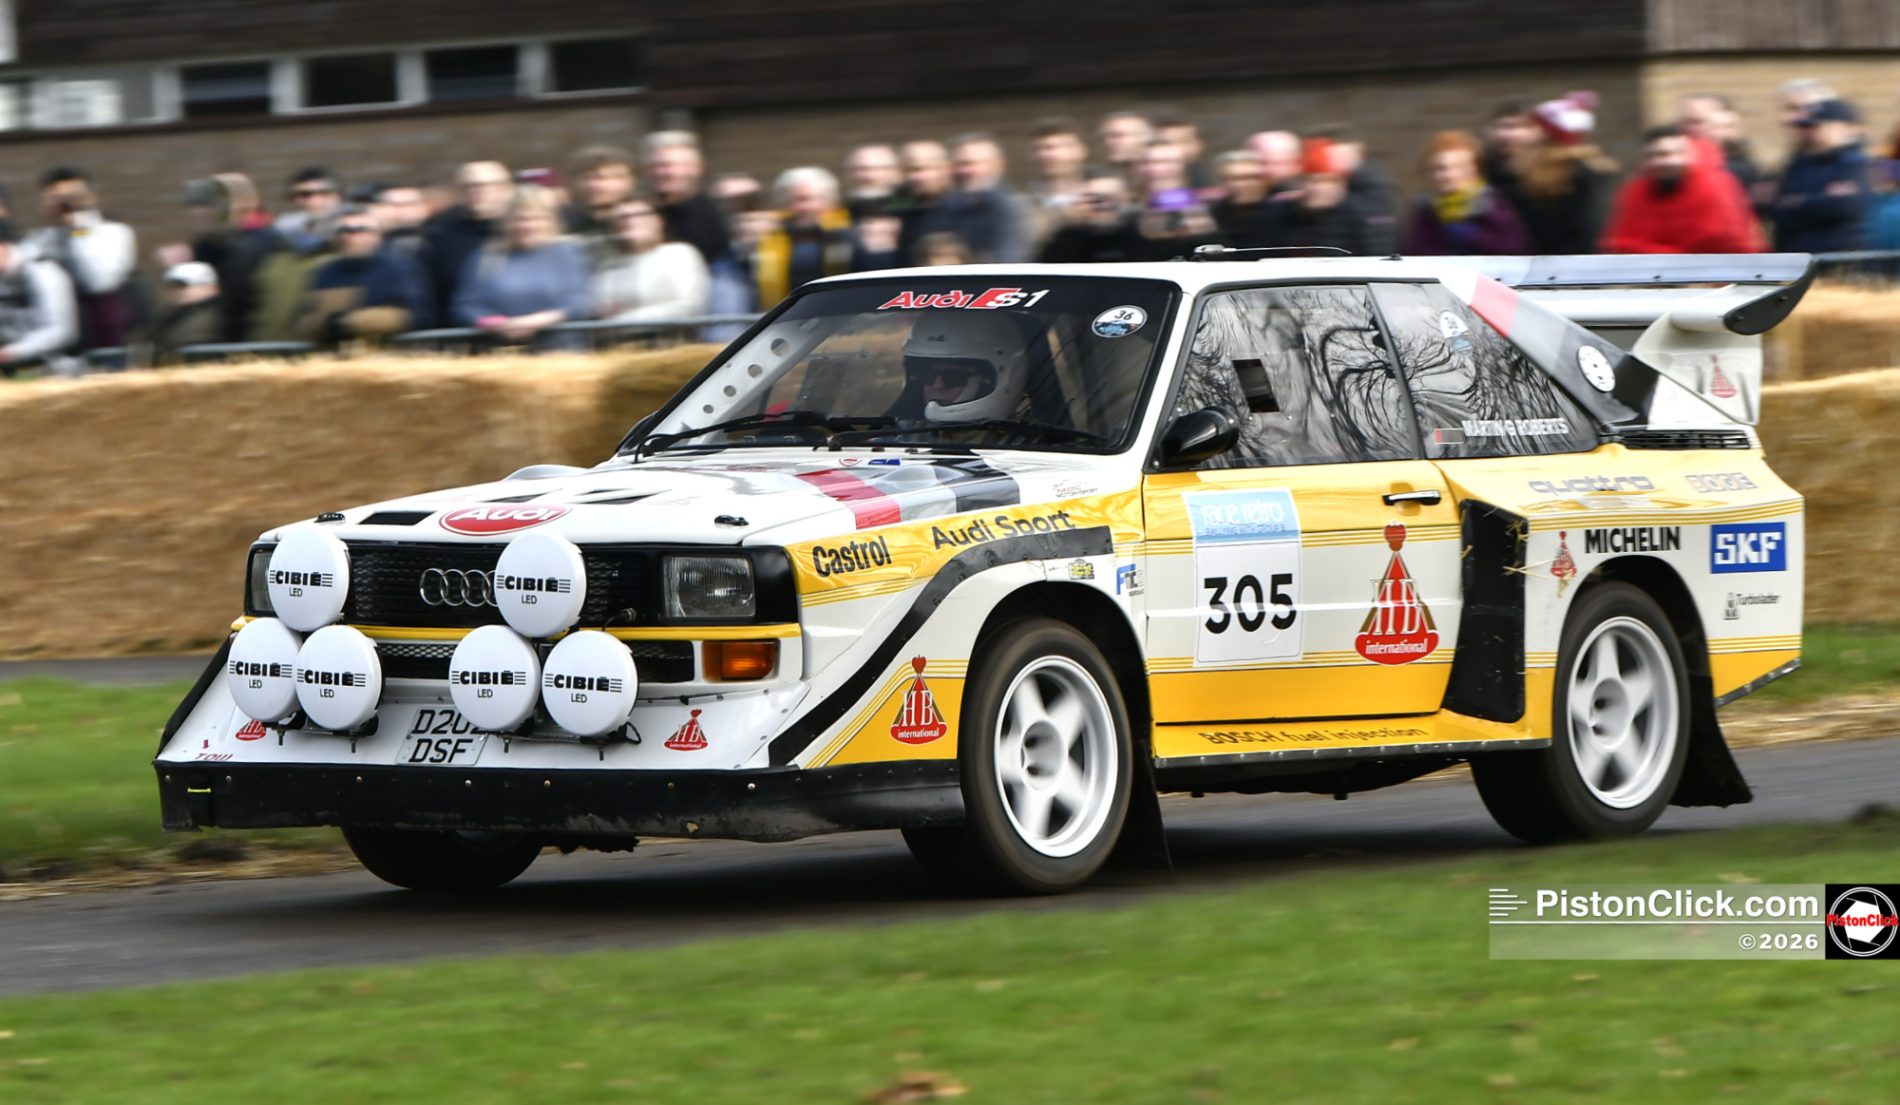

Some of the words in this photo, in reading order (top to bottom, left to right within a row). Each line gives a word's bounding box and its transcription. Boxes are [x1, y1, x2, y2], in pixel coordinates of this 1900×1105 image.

[877, 289, 974, 310] Audi
[984, 288, 1050, 308] S1
[1114, 310, 1135, 321] 36
[1527, 475, 1655, 496] quattro
[448, 508, 561, 521] Audi
[931, 520, 996, 550] Audi
[996, 510, 1075, 540] Sport
[1584, 526, 1681, 553] MICHELIN
[811, 536, 892, 577] Castrol
[1713, 531, 1782, 565] SKF
[289, 587, 303, 597] LED
[521, 594, 537, 604] LED
[1203, 573, 1297, 634] 305
[1370, 578, 1422, 636] HB
[1365, 637, 1429, 655] international
[248, 679, 263, 689] LED
[319, 688, 335, 698] LED
[477, 688, 493, 698] LED
[570, 694, 588, 703] LED
[902, 689, 933, 727] HB
[898, 727, 939, 738] international
[1198, 730, 1285, 745] BOSCH
[1280, 729, 1330, 742] fuel
[1324, 726, 1428, 741] injection
[408, 738, 474, 763] DSF
